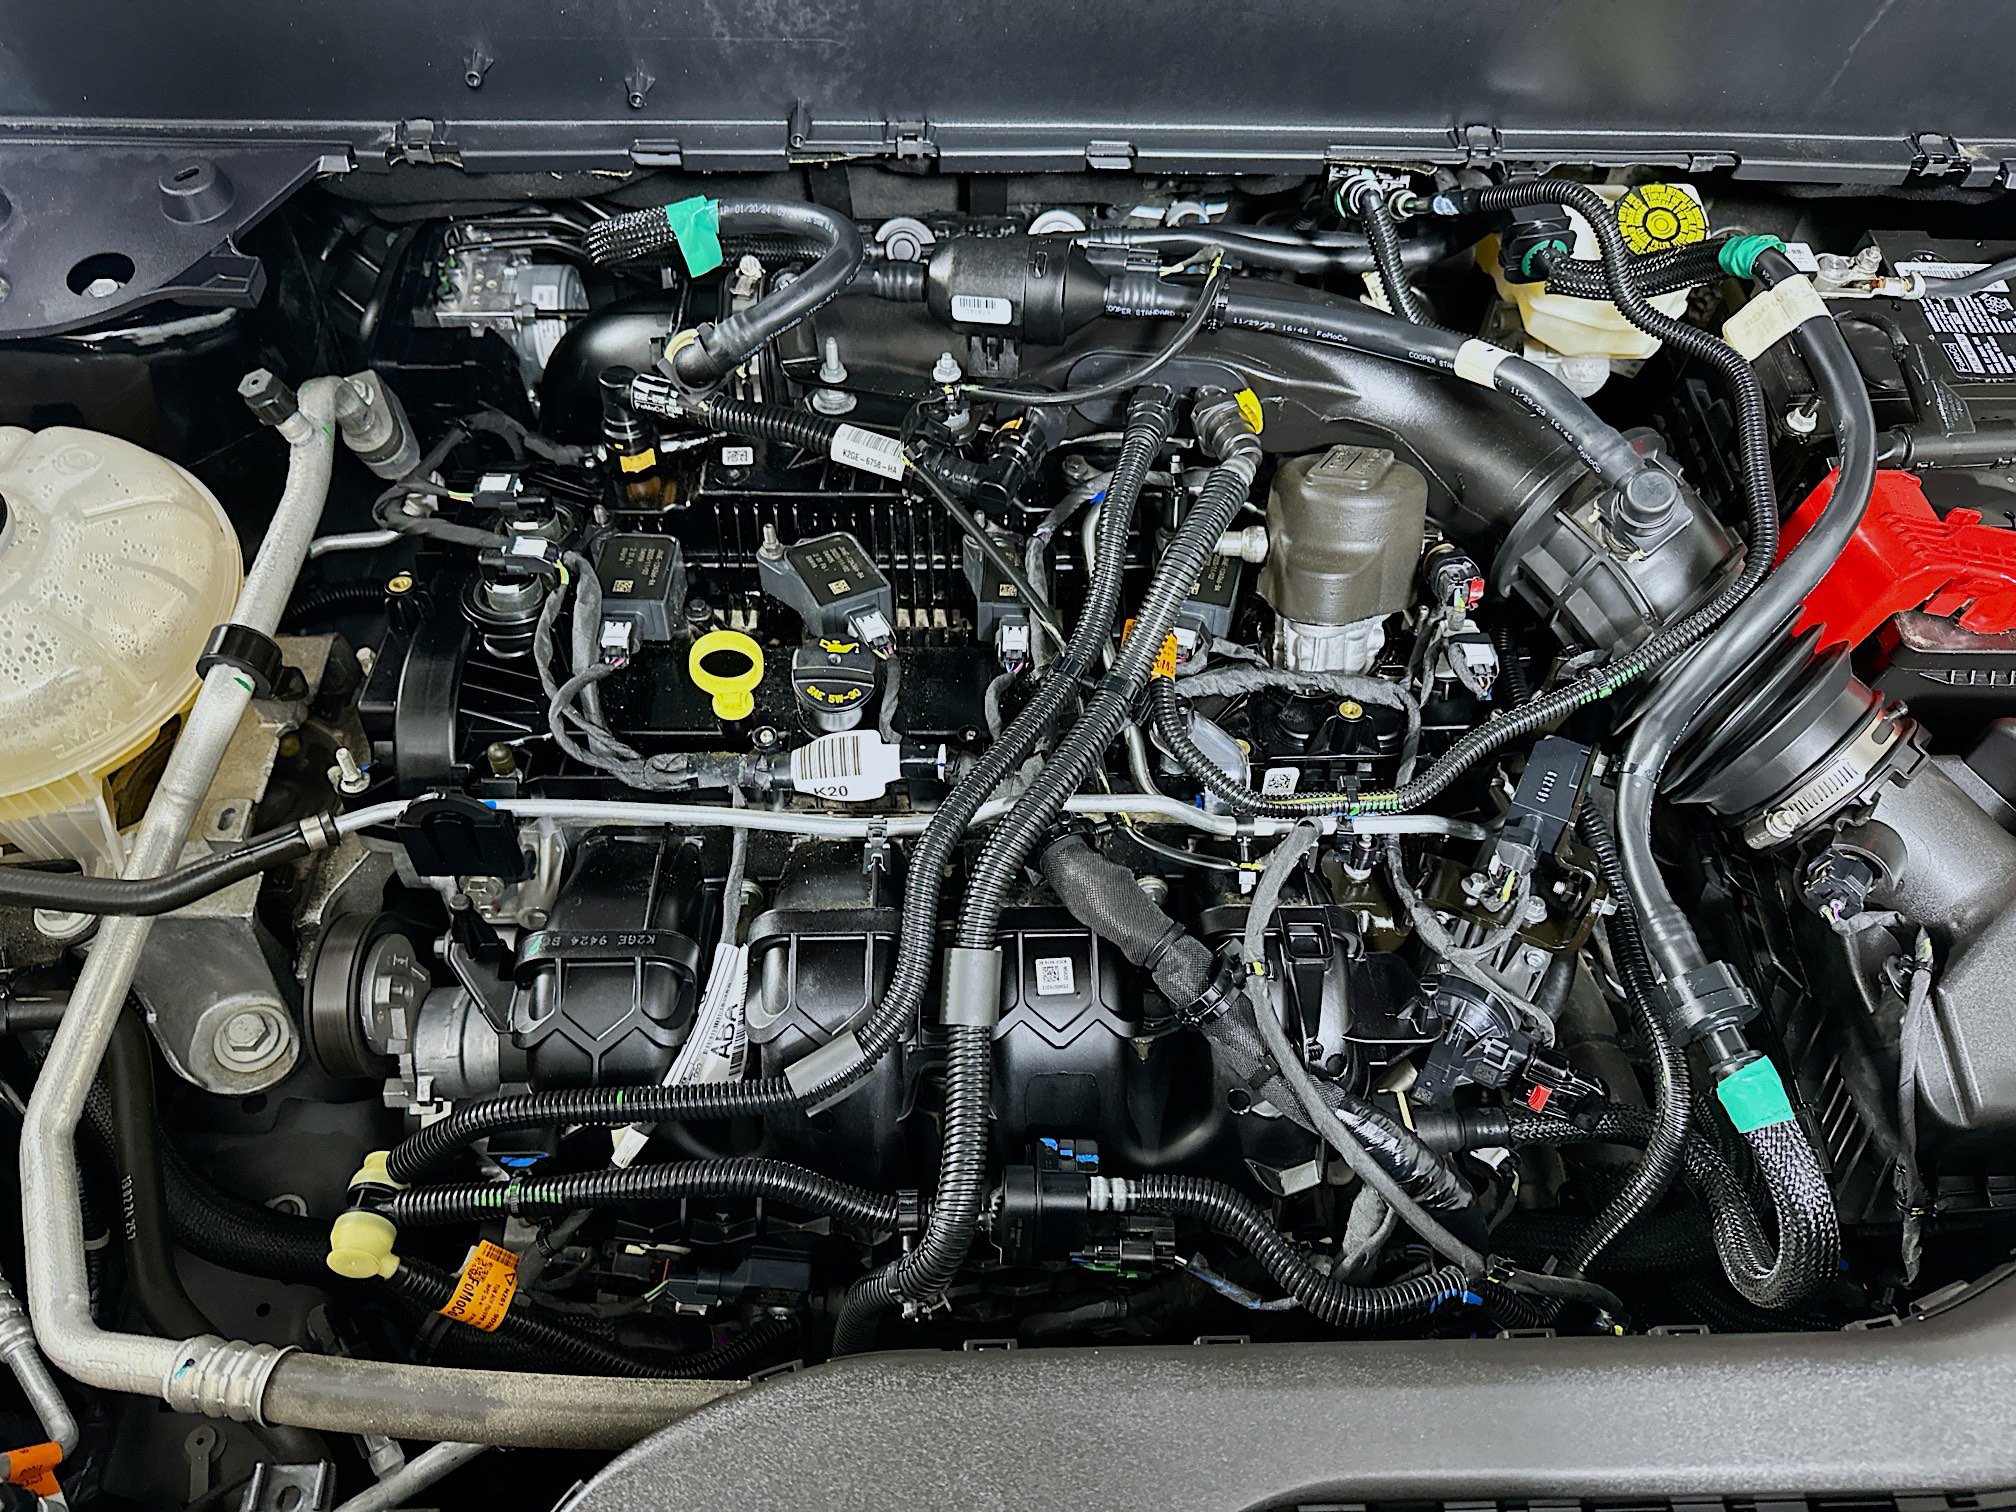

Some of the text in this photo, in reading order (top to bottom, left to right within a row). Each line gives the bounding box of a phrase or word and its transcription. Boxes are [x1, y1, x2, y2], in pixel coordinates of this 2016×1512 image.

[734, 203, 771, 214] 01/30/24
[1136, 308, 1175, 317] STANDARD
[765, 317, 802, 343] STANDARD
[1232, 316, 1348, 342] 11/29/23 16:46 FoMoCo
[1408, 351, 1437, 365] COOPER
[1510, 386, 1602, 474] 11/29/23 16:46 FoMoCo
[807, 685, 862, 704] SAE 5W-30
[814, 785, 848, 797] K20
[570, 934, 607, 946] 9424
[447, 1276, 480, 1317] FoMoCo
